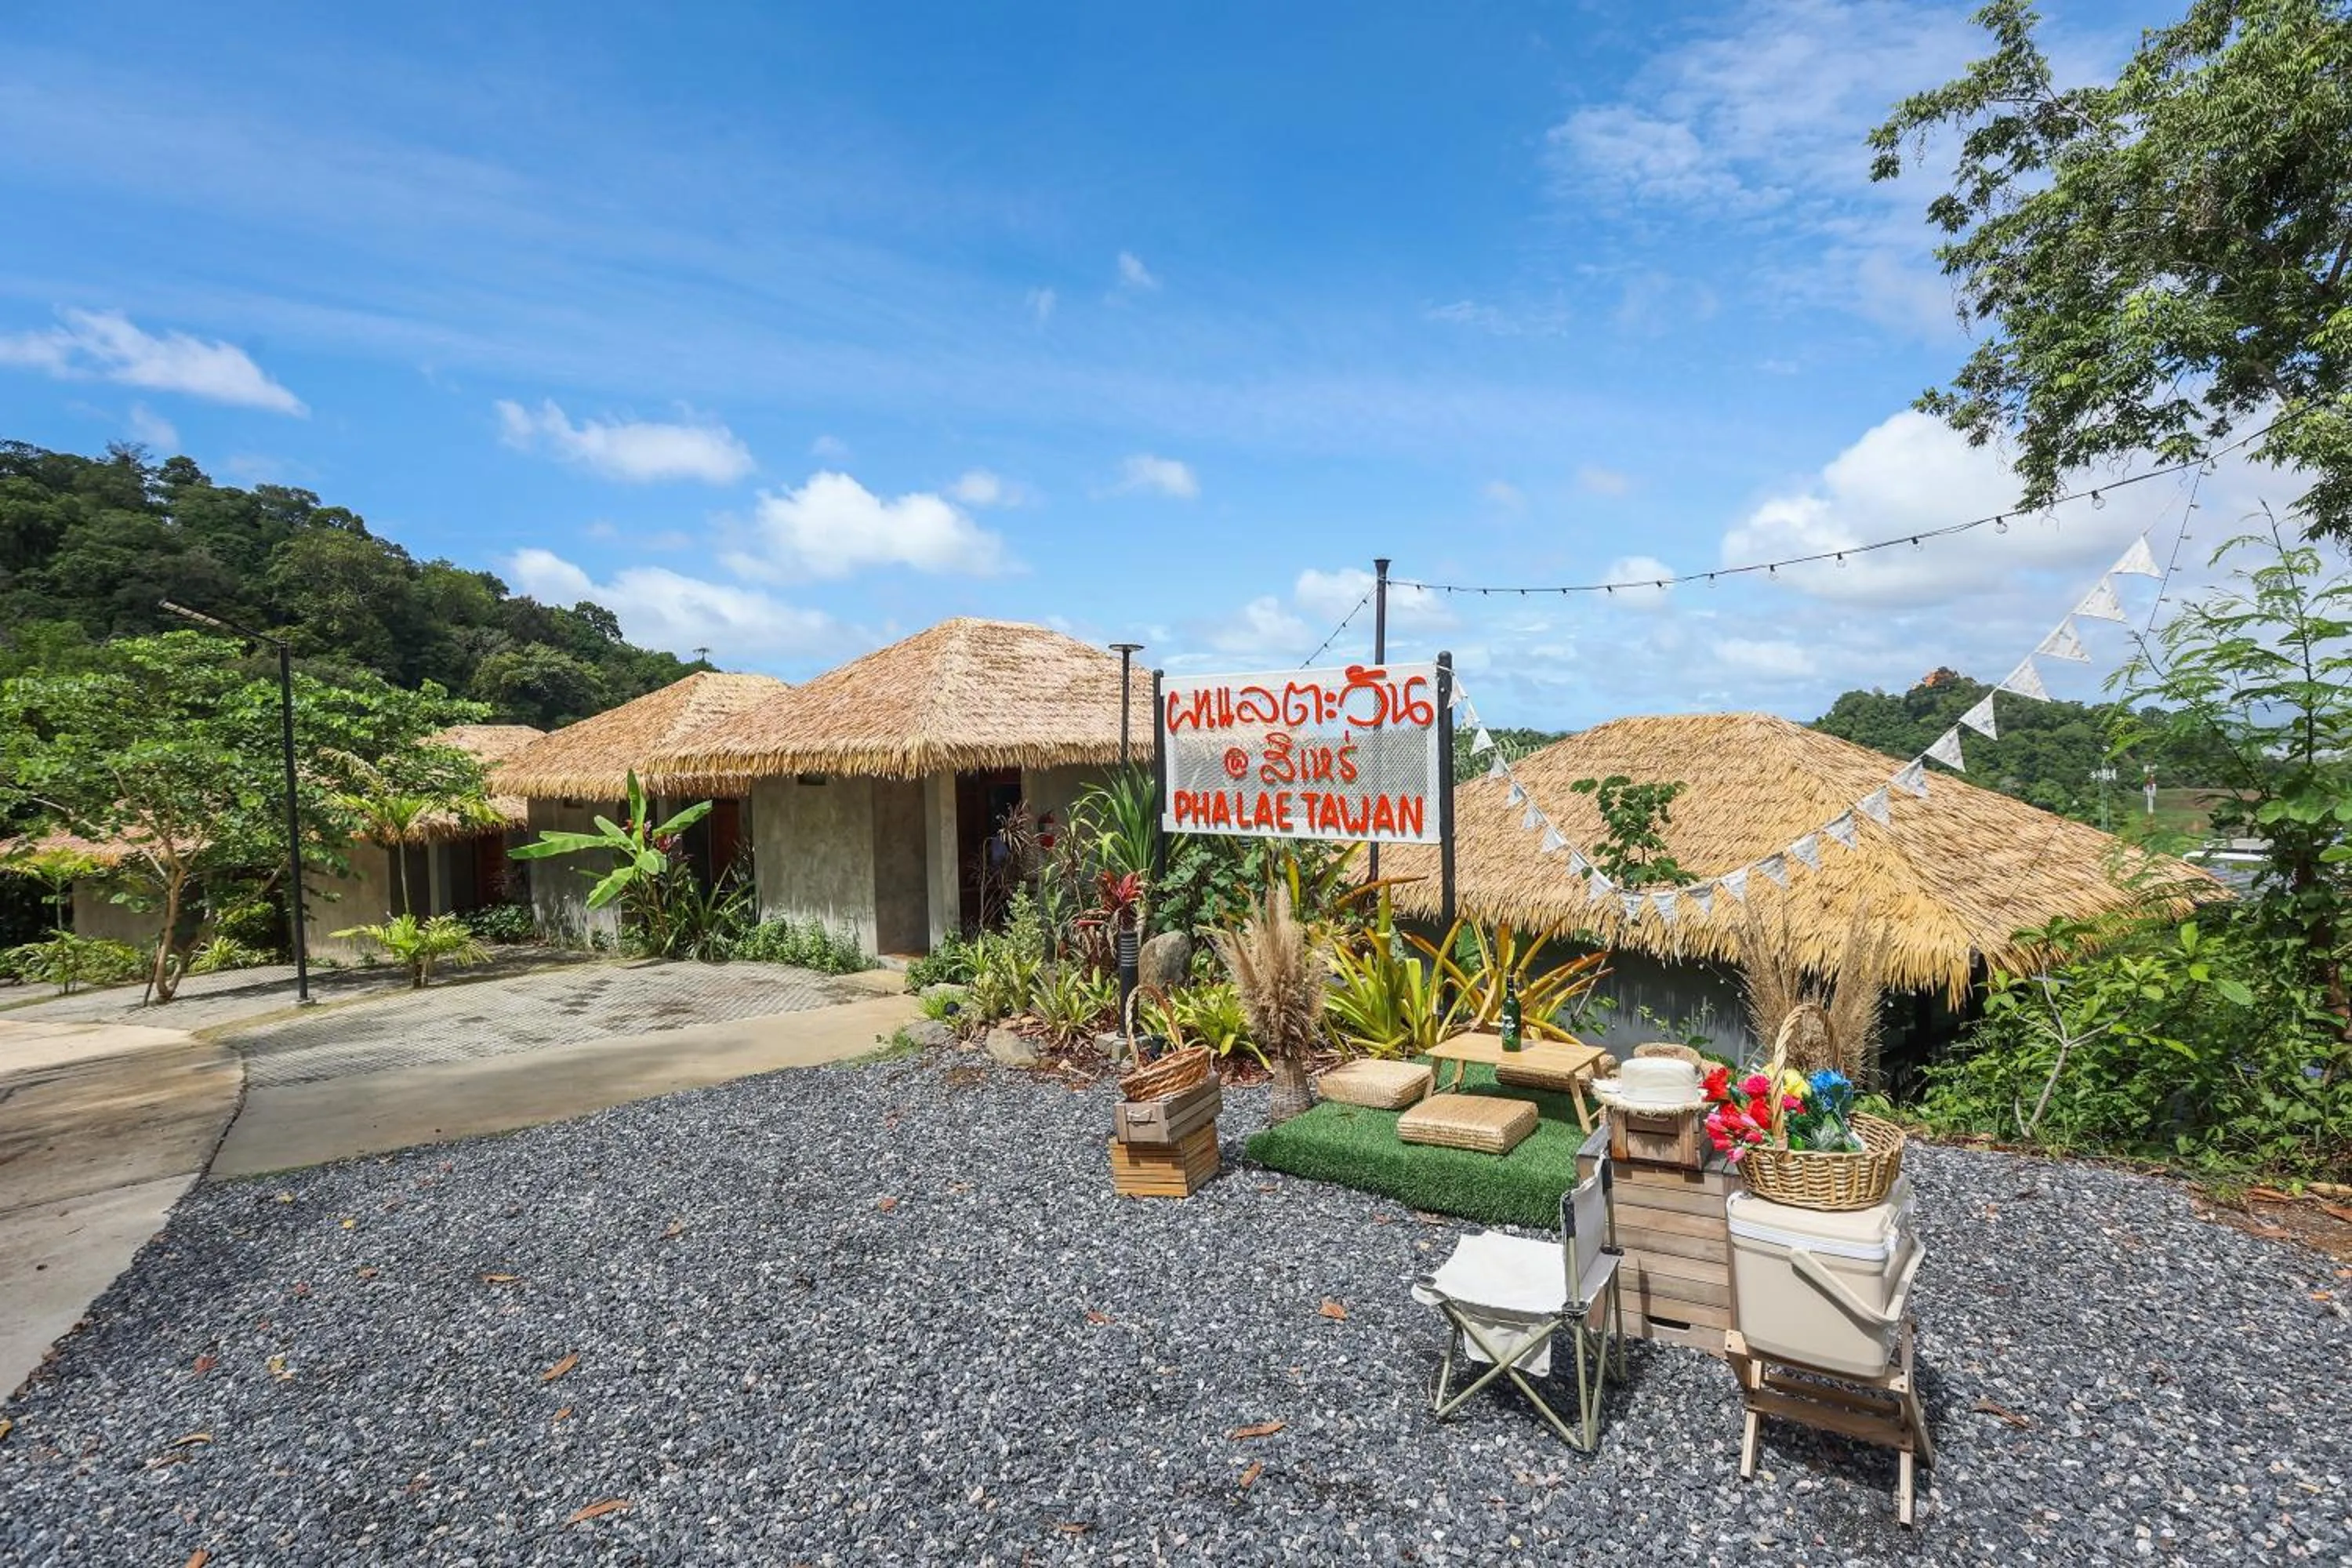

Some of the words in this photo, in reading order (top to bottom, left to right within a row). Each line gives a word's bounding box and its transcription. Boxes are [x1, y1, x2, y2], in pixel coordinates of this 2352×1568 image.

[1225, 747, 1248, 779] @
[1174, 789, 1292, 829] PHALAE
[1301, 792, 1423, 834] TAWAN
